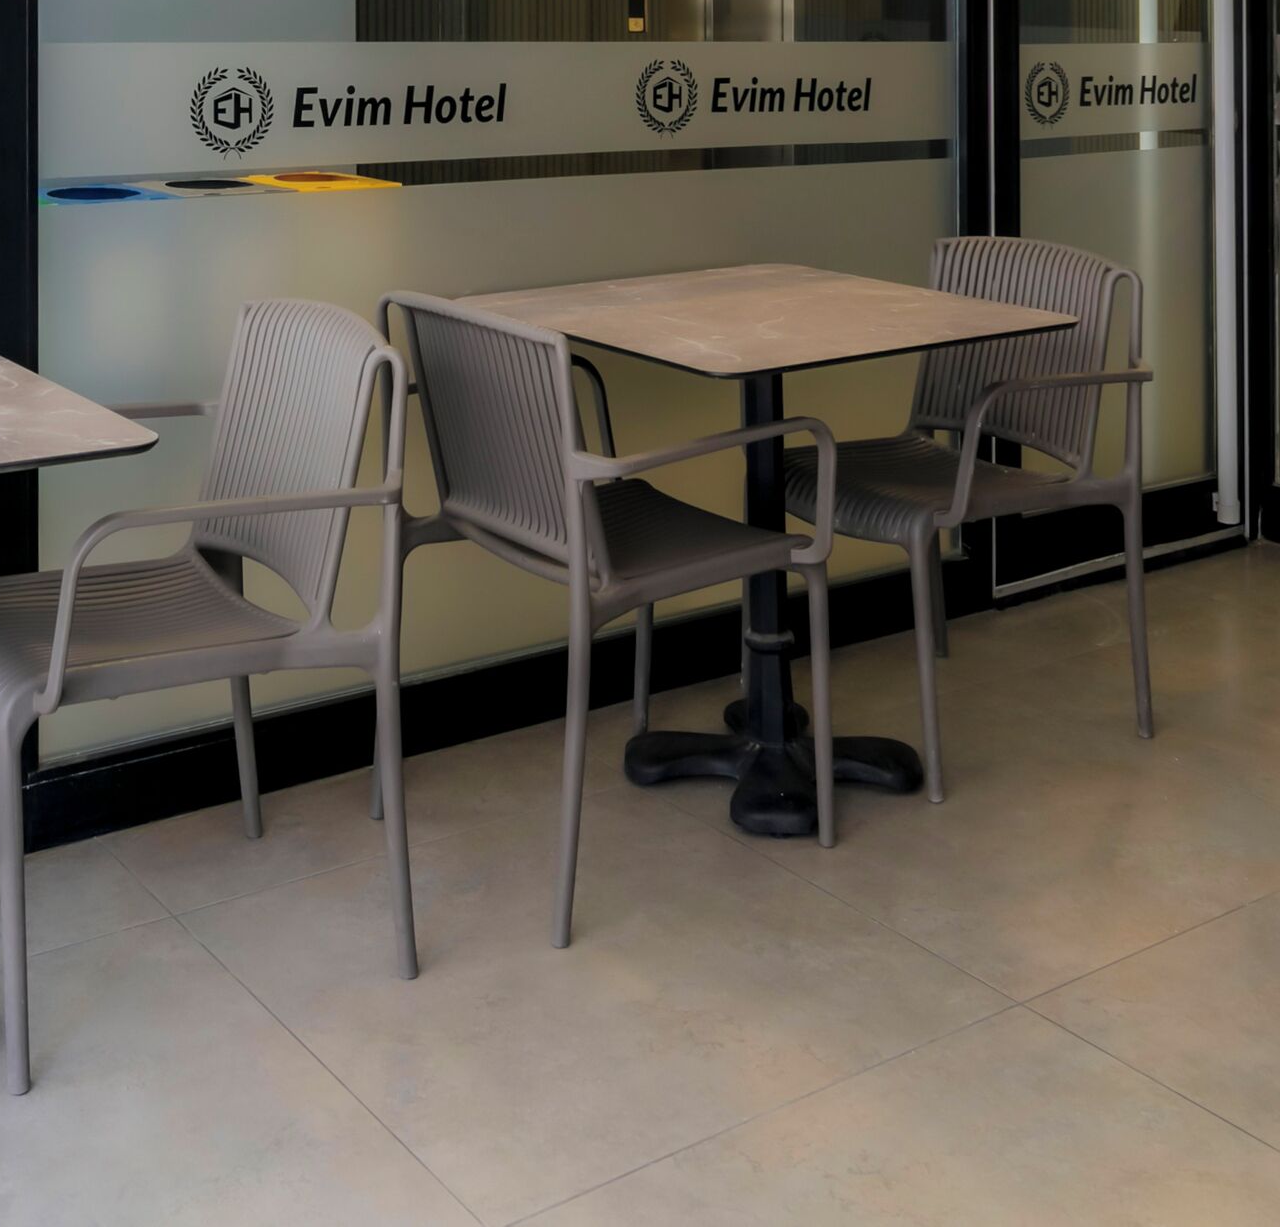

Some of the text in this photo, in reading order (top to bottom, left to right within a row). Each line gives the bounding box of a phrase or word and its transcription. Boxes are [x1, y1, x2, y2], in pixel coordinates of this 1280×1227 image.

[292, 82, 507, 128] Evim Hotel
[711, 77, 872, 113] Evim Hotel
[1079, 74, 1198, 107] Evim Hotel
